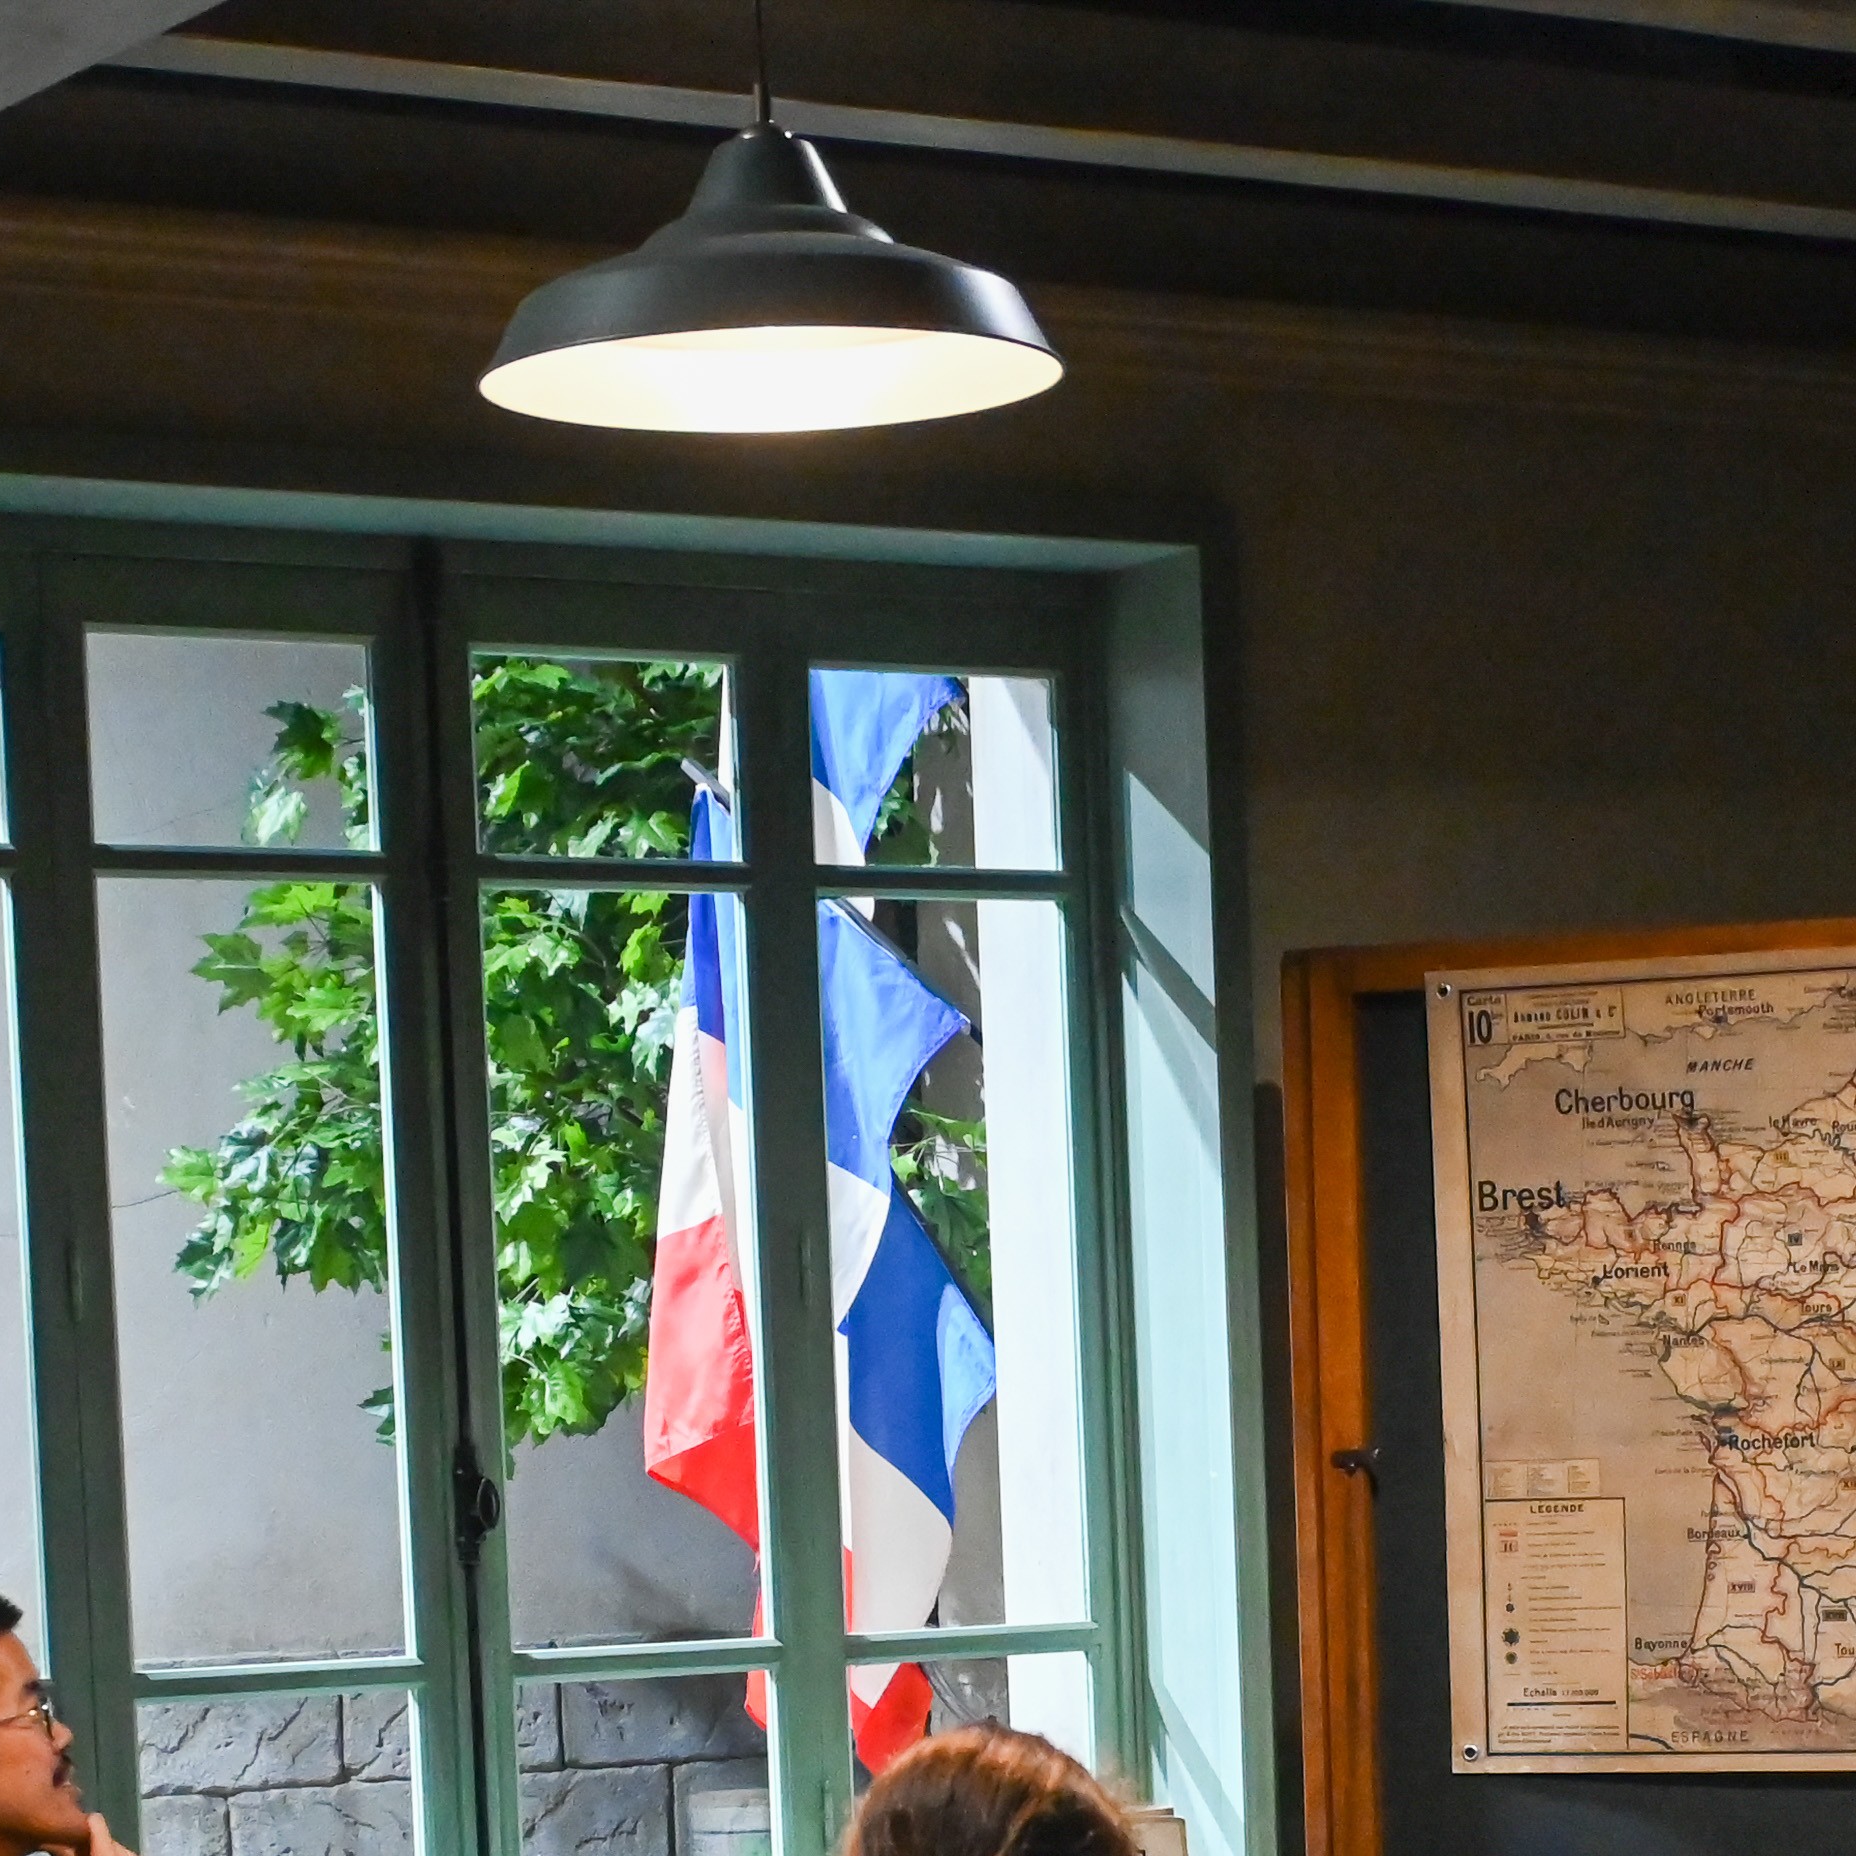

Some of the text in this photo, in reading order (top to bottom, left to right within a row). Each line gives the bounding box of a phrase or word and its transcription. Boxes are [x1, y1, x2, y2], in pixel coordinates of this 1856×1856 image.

[1664, 989, 1757, 1006] ANGLETERRE
[1467, 1009, 1493, 1045] 10
[1686, 1057, 1755, 1074] MANCHE
[1554, 1086, 1695, 1116] Cherbourg
[1477, 1179, 1566, 1212] Brest
[1602, 1261, 1670, 1280] Lorient
[1728, 1426, 1816, 1451] Rochefort
[1686, 1527, 1742, 1540] Bordeaux
[1634, 1636, 1689, 1652] Bayonne
[1670, 1729, 1749, 1744] ESPAGNE
